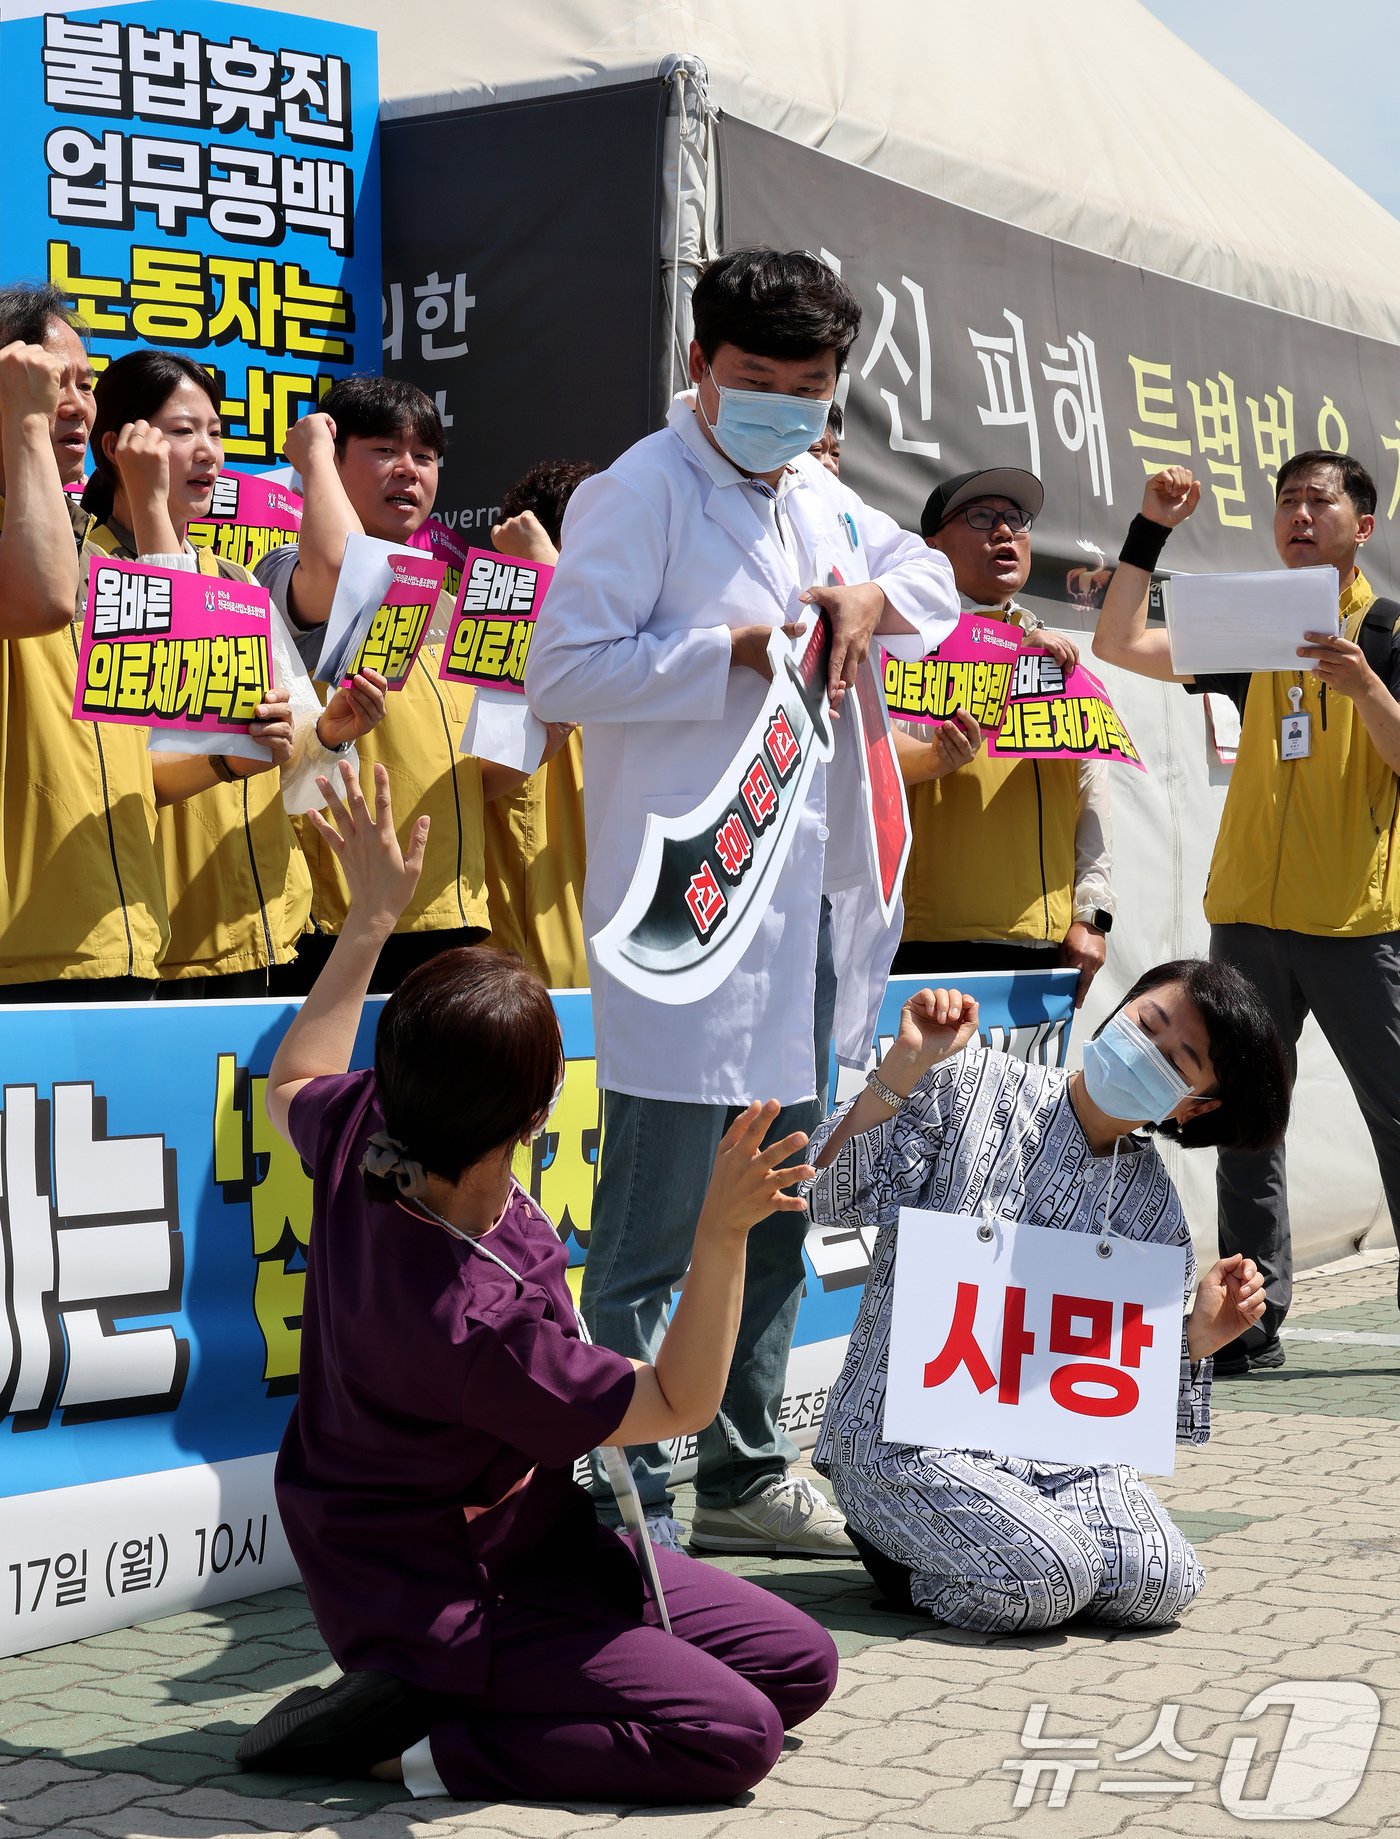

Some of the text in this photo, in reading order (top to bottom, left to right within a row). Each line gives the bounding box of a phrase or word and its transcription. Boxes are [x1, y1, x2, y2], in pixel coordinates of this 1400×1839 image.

[42, 13, 354, 151] 불법휴진
[44, 126, 354, 257] 업무공백
[47, 240, 356, 366] 노동자는
[967, 307, 1114, 506] 피해
[92, 567, 172, 640] 올바른
[461, 557, 538, 616] 올바른
[82, 635, 274, 725] 의료체계확립!
[884, 658, 1014, 732] 의료체계확립!
[923, 1281, 1155, 1419] 사망
[8, 1514, 268, 1616] 17일 (월) 10시
